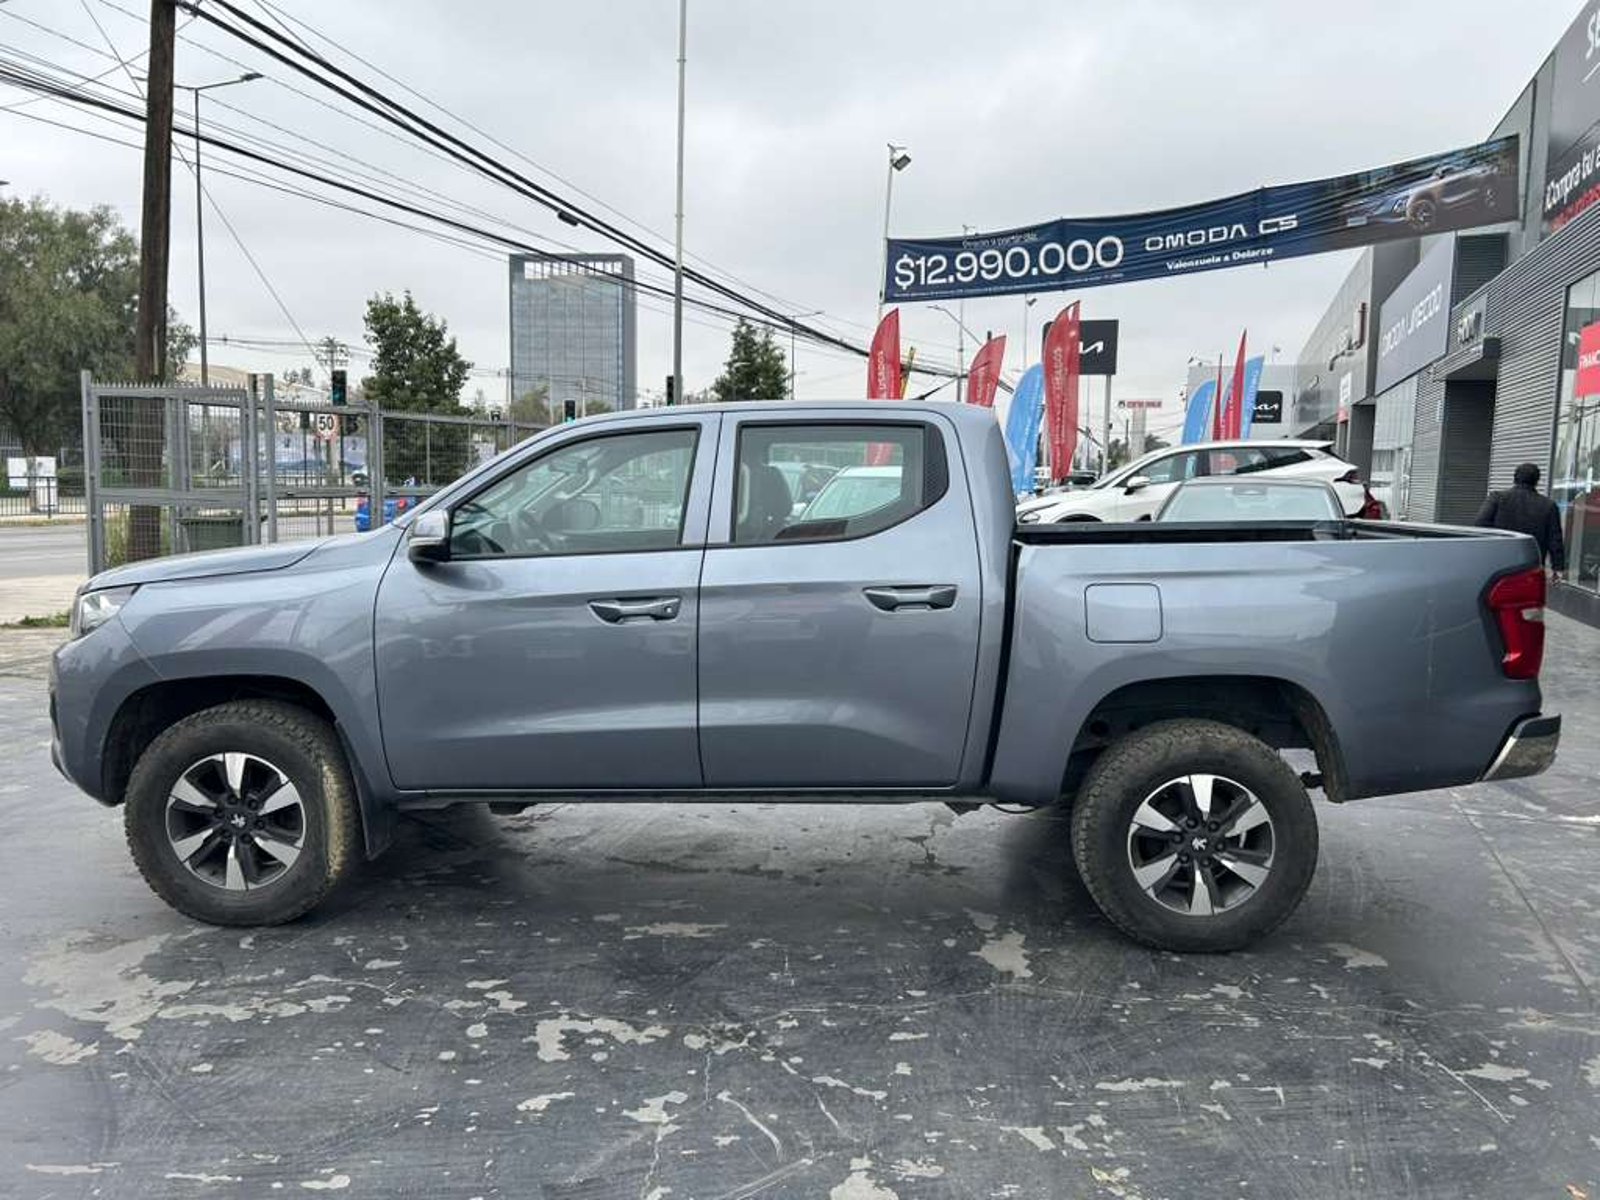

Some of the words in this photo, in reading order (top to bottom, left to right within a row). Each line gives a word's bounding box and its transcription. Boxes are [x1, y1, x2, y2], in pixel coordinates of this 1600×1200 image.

[1145, 223, 1247, 251] OMODA
[894, 235, 1124, 291] $12.990.000
[1166, 255, 1221, 270] Valenzuela
[318, 415, 335, 431] 50
